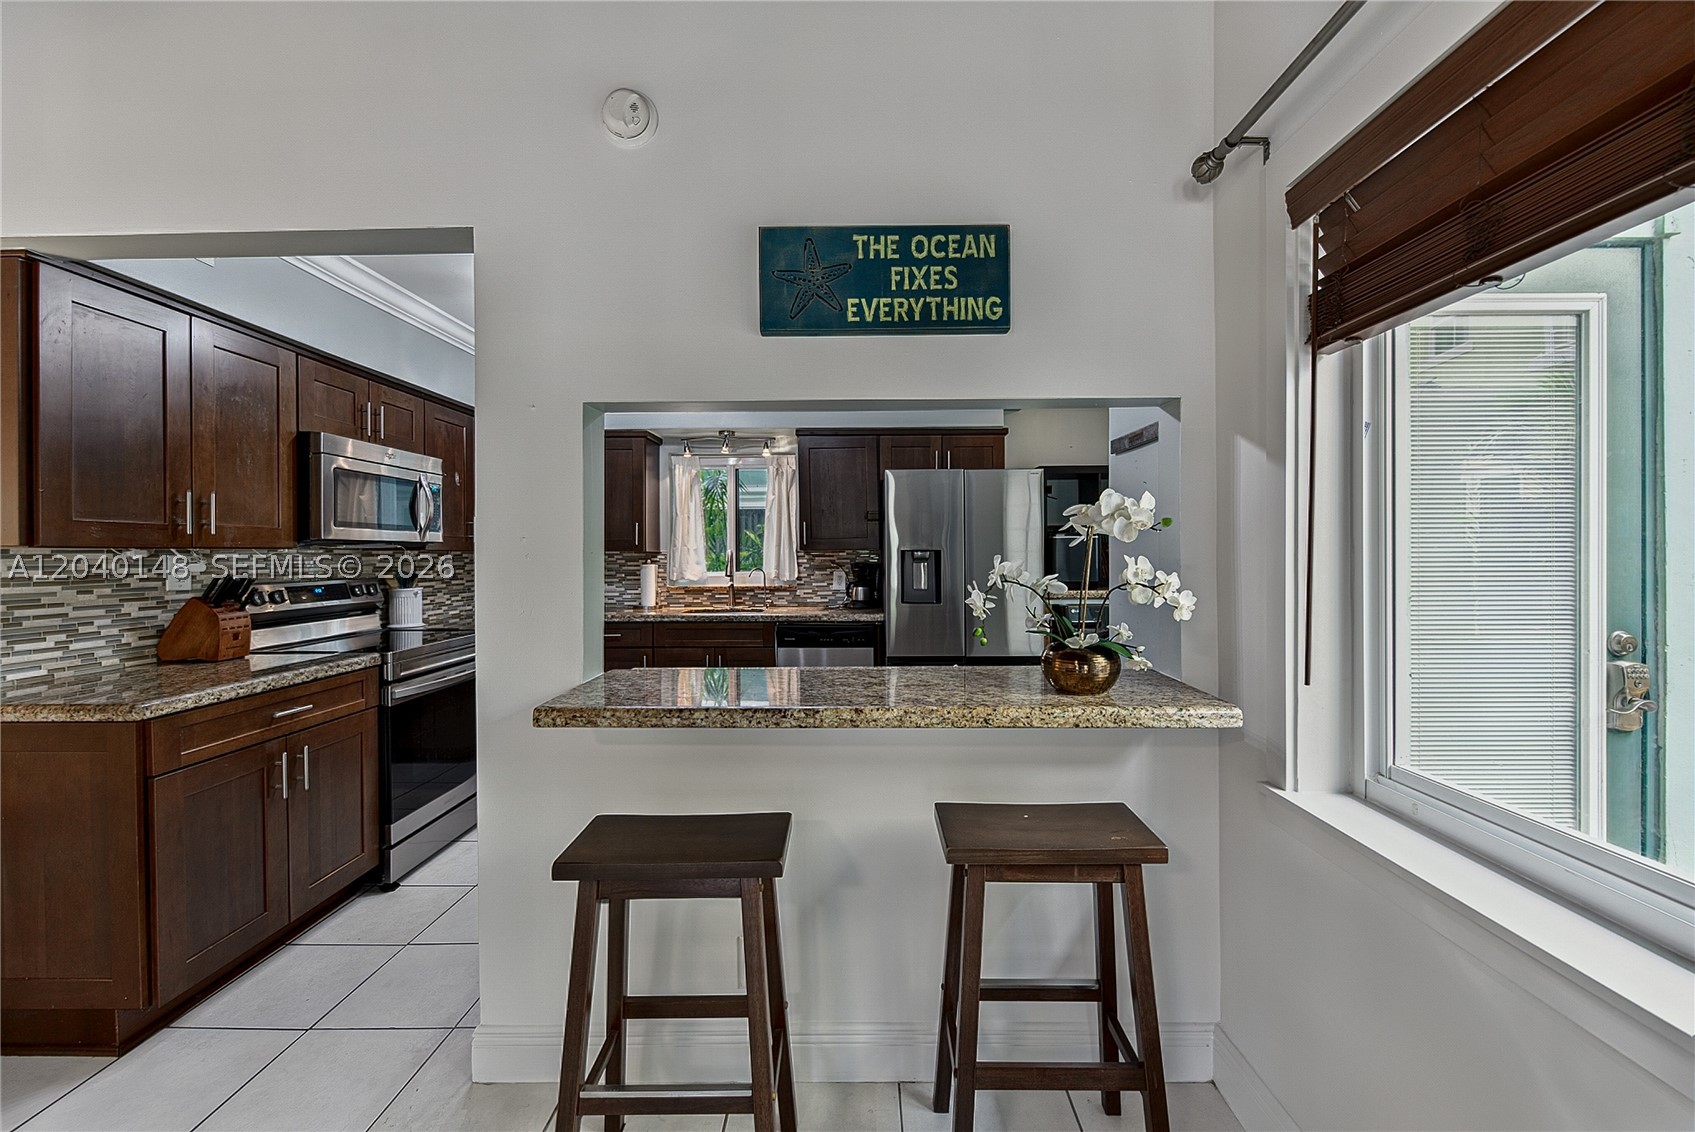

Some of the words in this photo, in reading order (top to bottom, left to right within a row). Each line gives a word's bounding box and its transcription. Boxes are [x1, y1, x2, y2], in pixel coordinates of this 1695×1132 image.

[852, 234, 900, 260] THE
[911, 234, 996, 259] OCEAN
[890, 265, 959, 291] FIXES
[846, 295, 1003, 323] EVERYTHING
